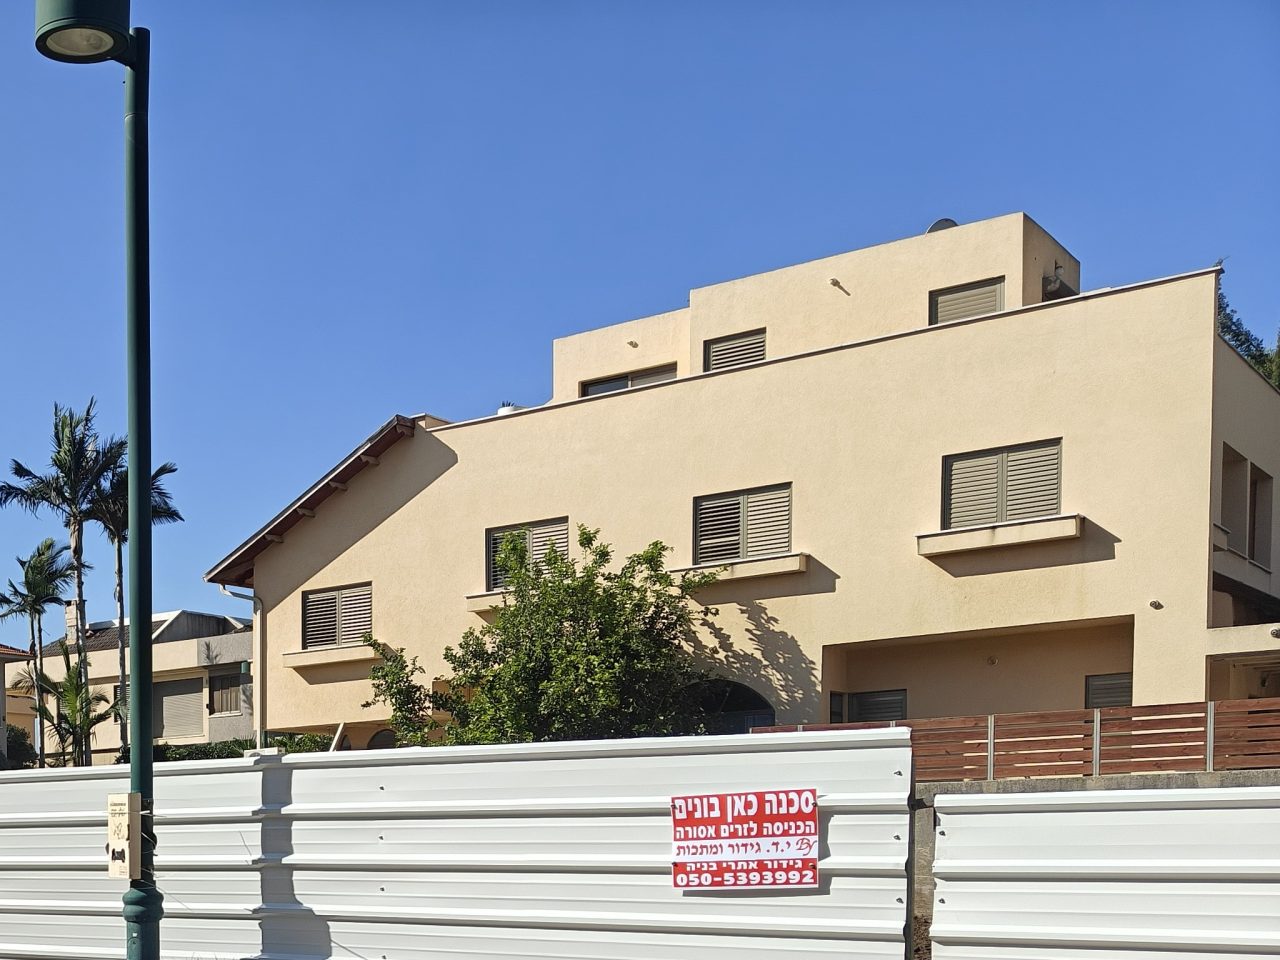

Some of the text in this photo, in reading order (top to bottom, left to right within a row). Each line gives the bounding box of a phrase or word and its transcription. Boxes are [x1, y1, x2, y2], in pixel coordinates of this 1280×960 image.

[675, 791, 813, 822] סכנה כאן בונים
[676, 821, 815, 838] הכניסה לזרים אסורה
[676, 843, 723, 856] ומתכות
[728, 843, 761, 854] גידור
[687, 860, 802, 870] גידור אתרי בניה
[677, 871, 814, 886] 050-5393992
